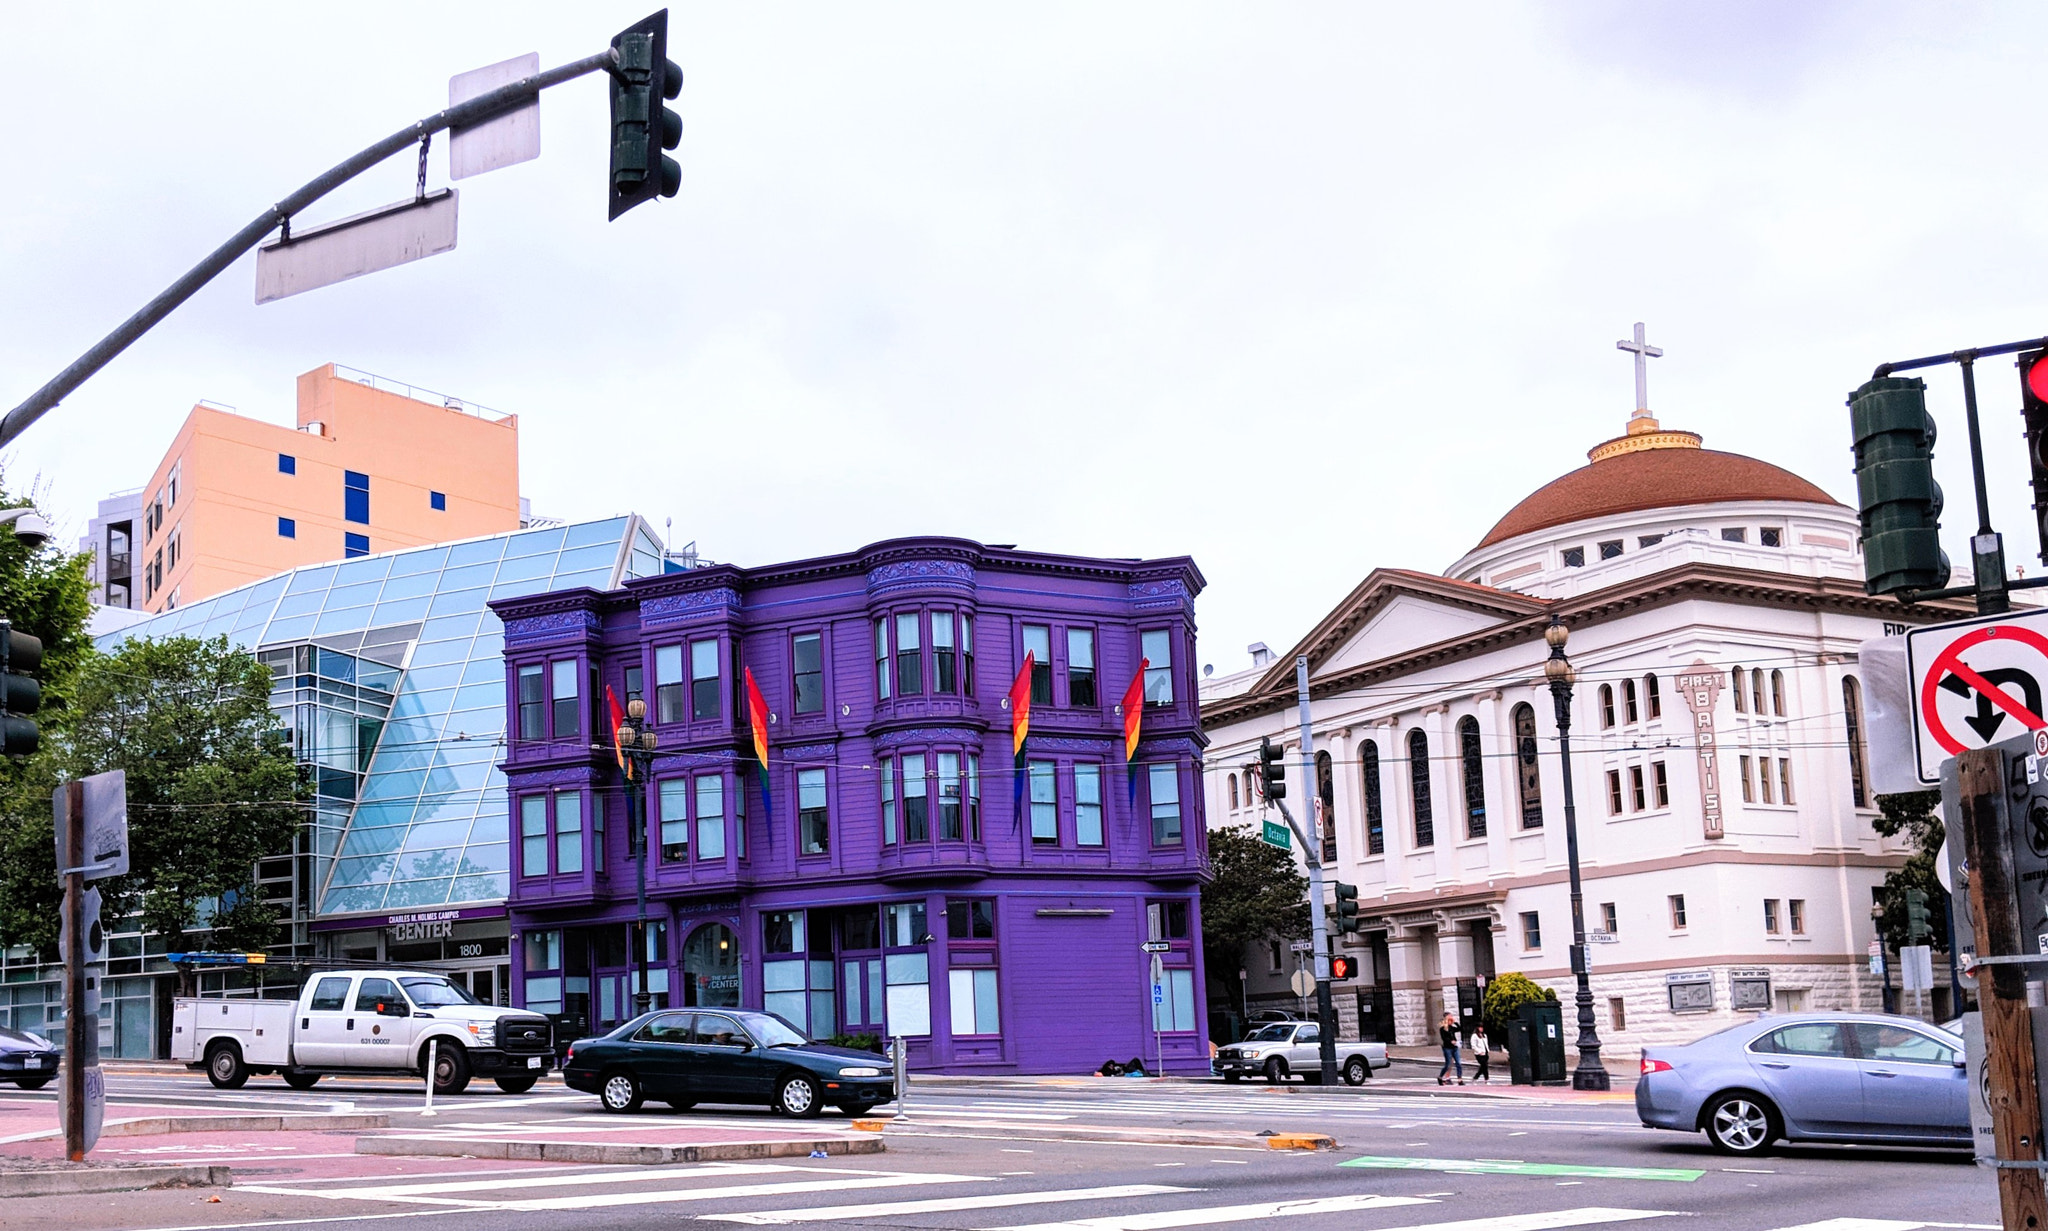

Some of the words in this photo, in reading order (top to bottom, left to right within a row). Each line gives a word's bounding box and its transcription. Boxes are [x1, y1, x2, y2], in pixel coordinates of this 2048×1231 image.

[1680, 674, 1722, 688] FIRST
[1695, 691, 1720, 831] BAPTIST
[1268, 826, 1286, 843] Octavia
[389, 914, 410, 924] CHARLES
[418, 912, 437, 921] HOLMES
[438, 911, 460, 919] CAMPUS
[395, 920, 453, 941] CENTER
[459, 943, 482, 956] 1800
[711, 979, 739, 989] CENTER
